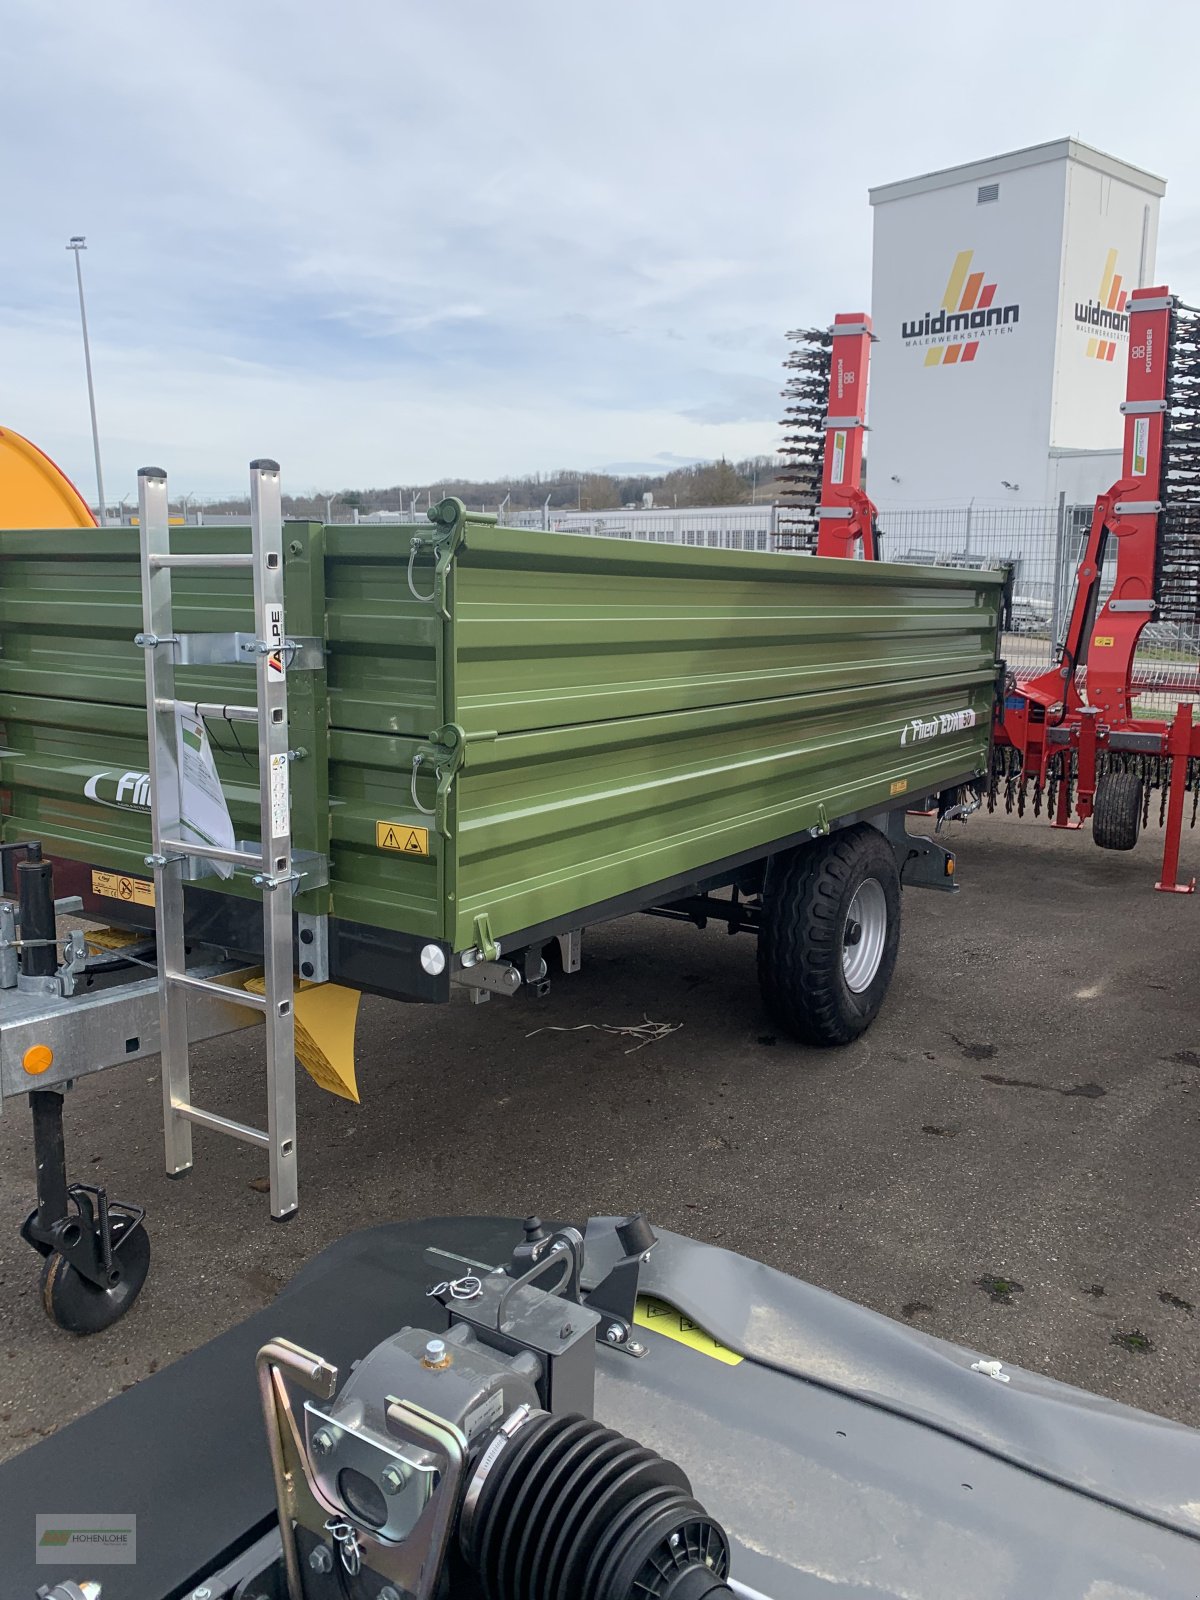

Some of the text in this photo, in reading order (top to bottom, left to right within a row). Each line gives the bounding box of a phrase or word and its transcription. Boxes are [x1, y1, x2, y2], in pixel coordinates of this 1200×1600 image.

[902, 305, 1020, 339] widmann
[1074, 299, 1130, 333] widman
[271, 610, 282, 664] ALPE
